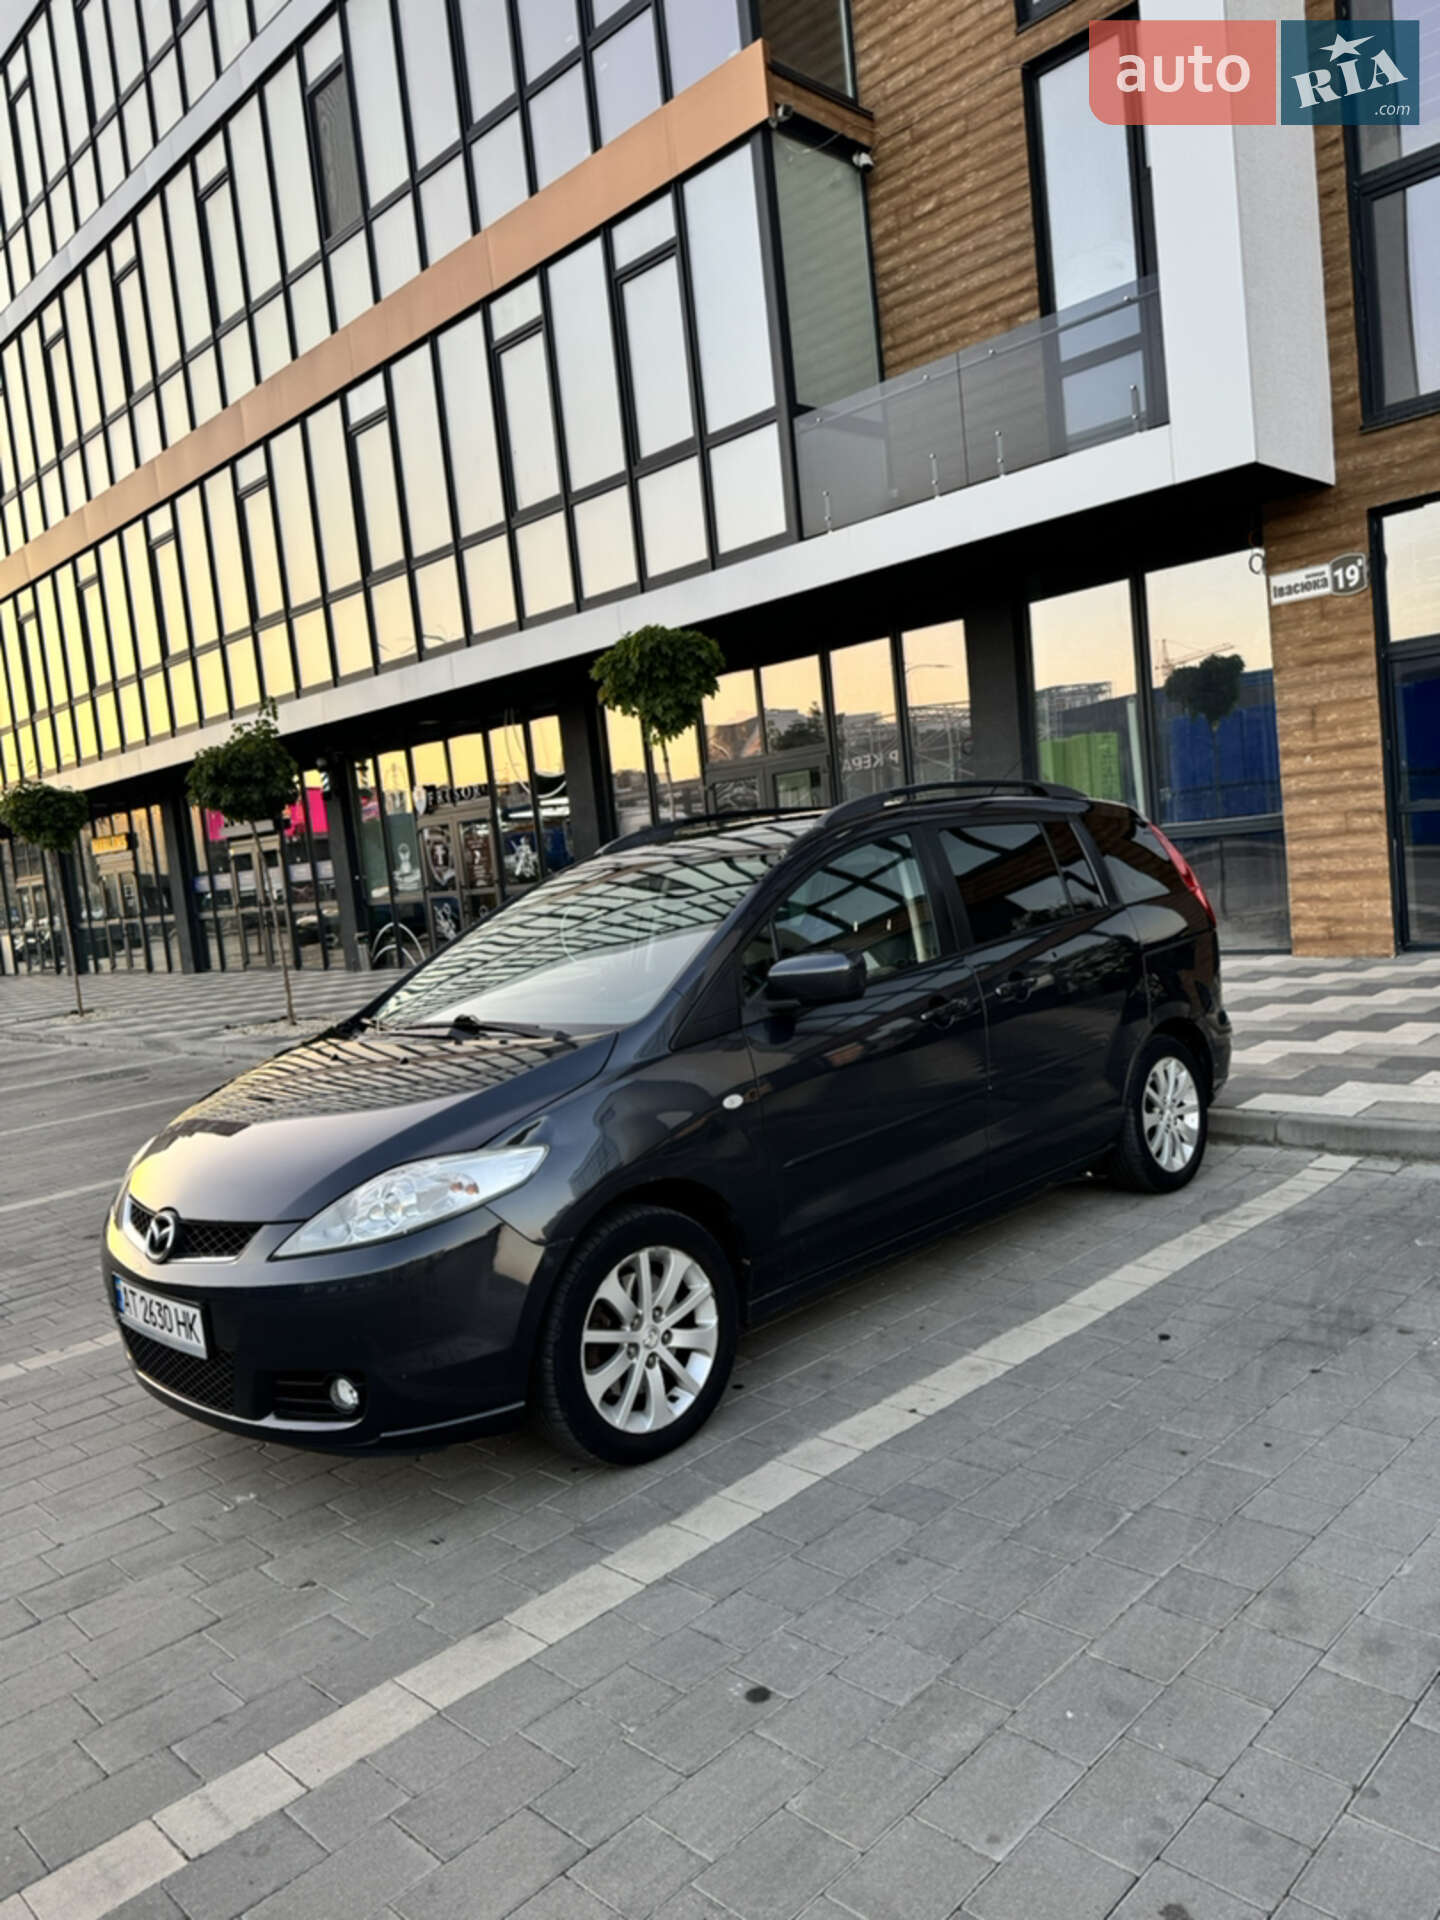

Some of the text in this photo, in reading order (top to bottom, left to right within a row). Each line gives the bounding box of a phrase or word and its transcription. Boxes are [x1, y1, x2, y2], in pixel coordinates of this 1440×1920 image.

[1273, 578, 1328, 598] Івасюка
[122, 1286, 201, 1344] AT 2630 HK
